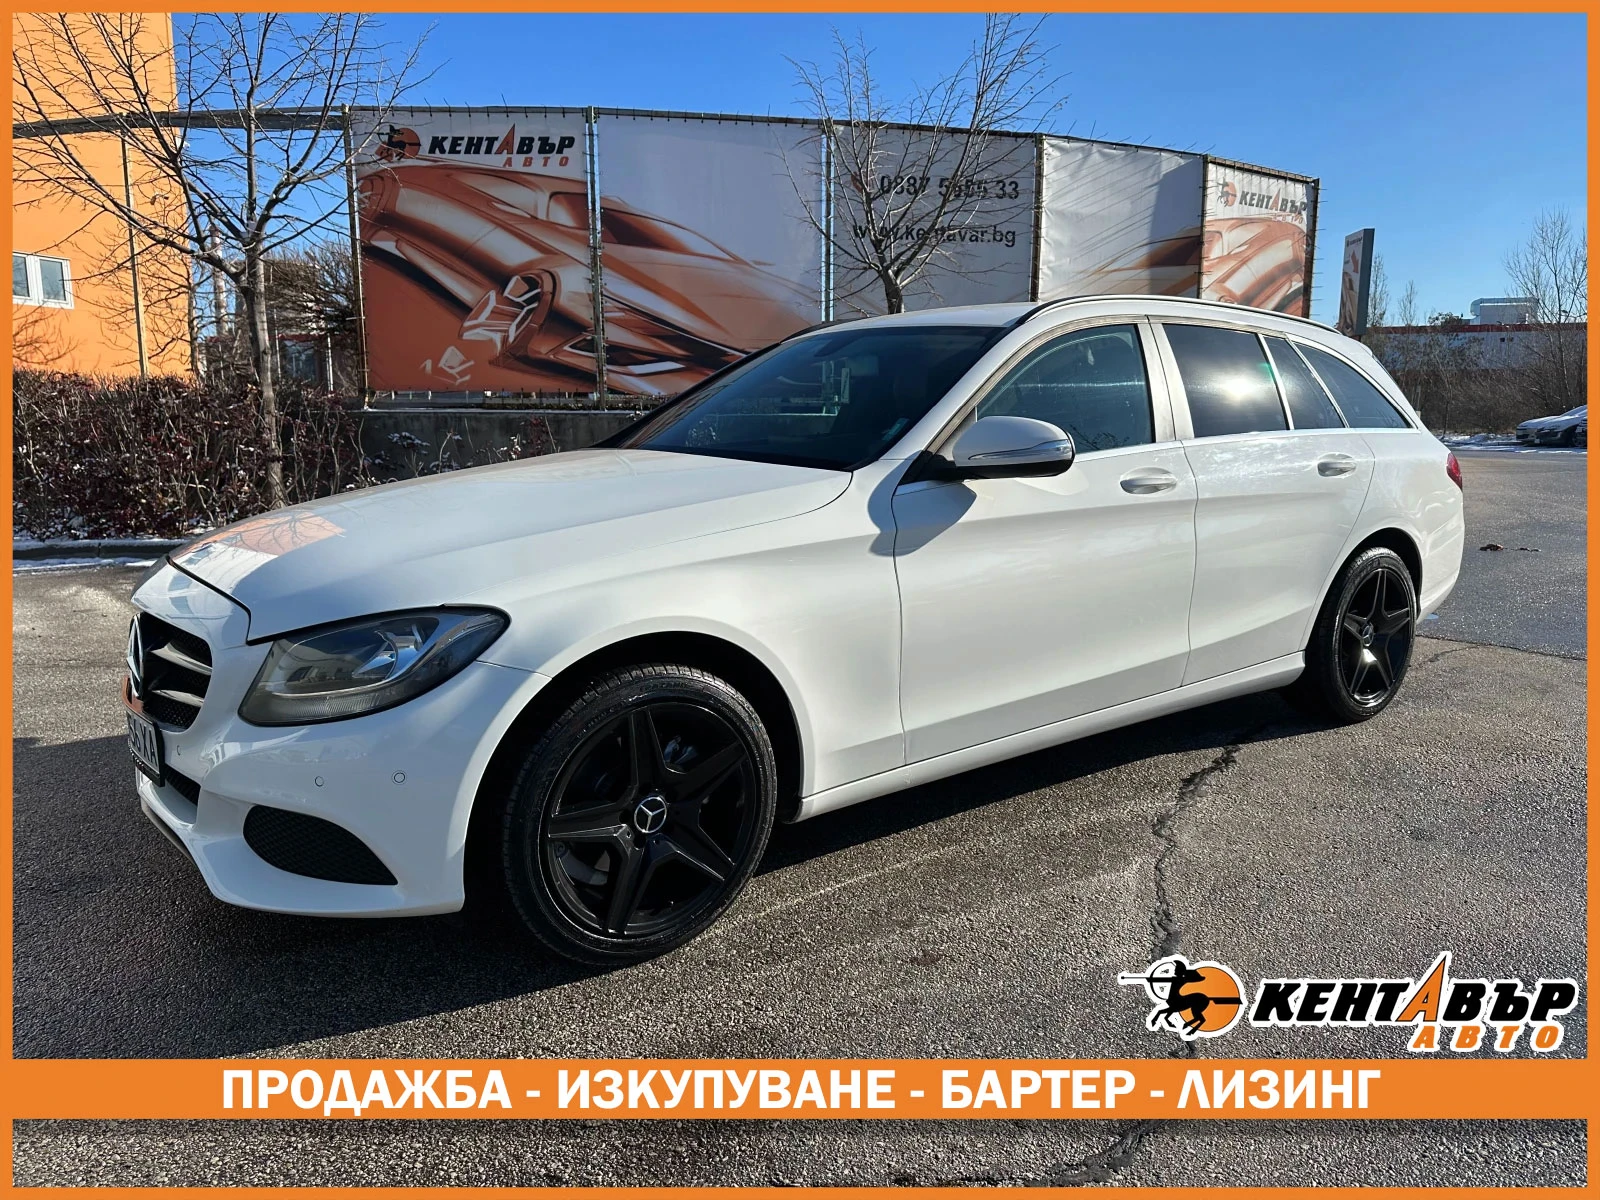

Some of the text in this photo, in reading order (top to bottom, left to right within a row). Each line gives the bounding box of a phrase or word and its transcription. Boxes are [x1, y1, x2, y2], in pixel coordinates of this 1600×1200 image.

[428, 123, 575, 154] КЕНТАВЪР
[503, 157, 569, 167] АВТО
[995, 180, 1019, 199] 33
[1239, 188, 1306, 214] КЕНТАВЪР
